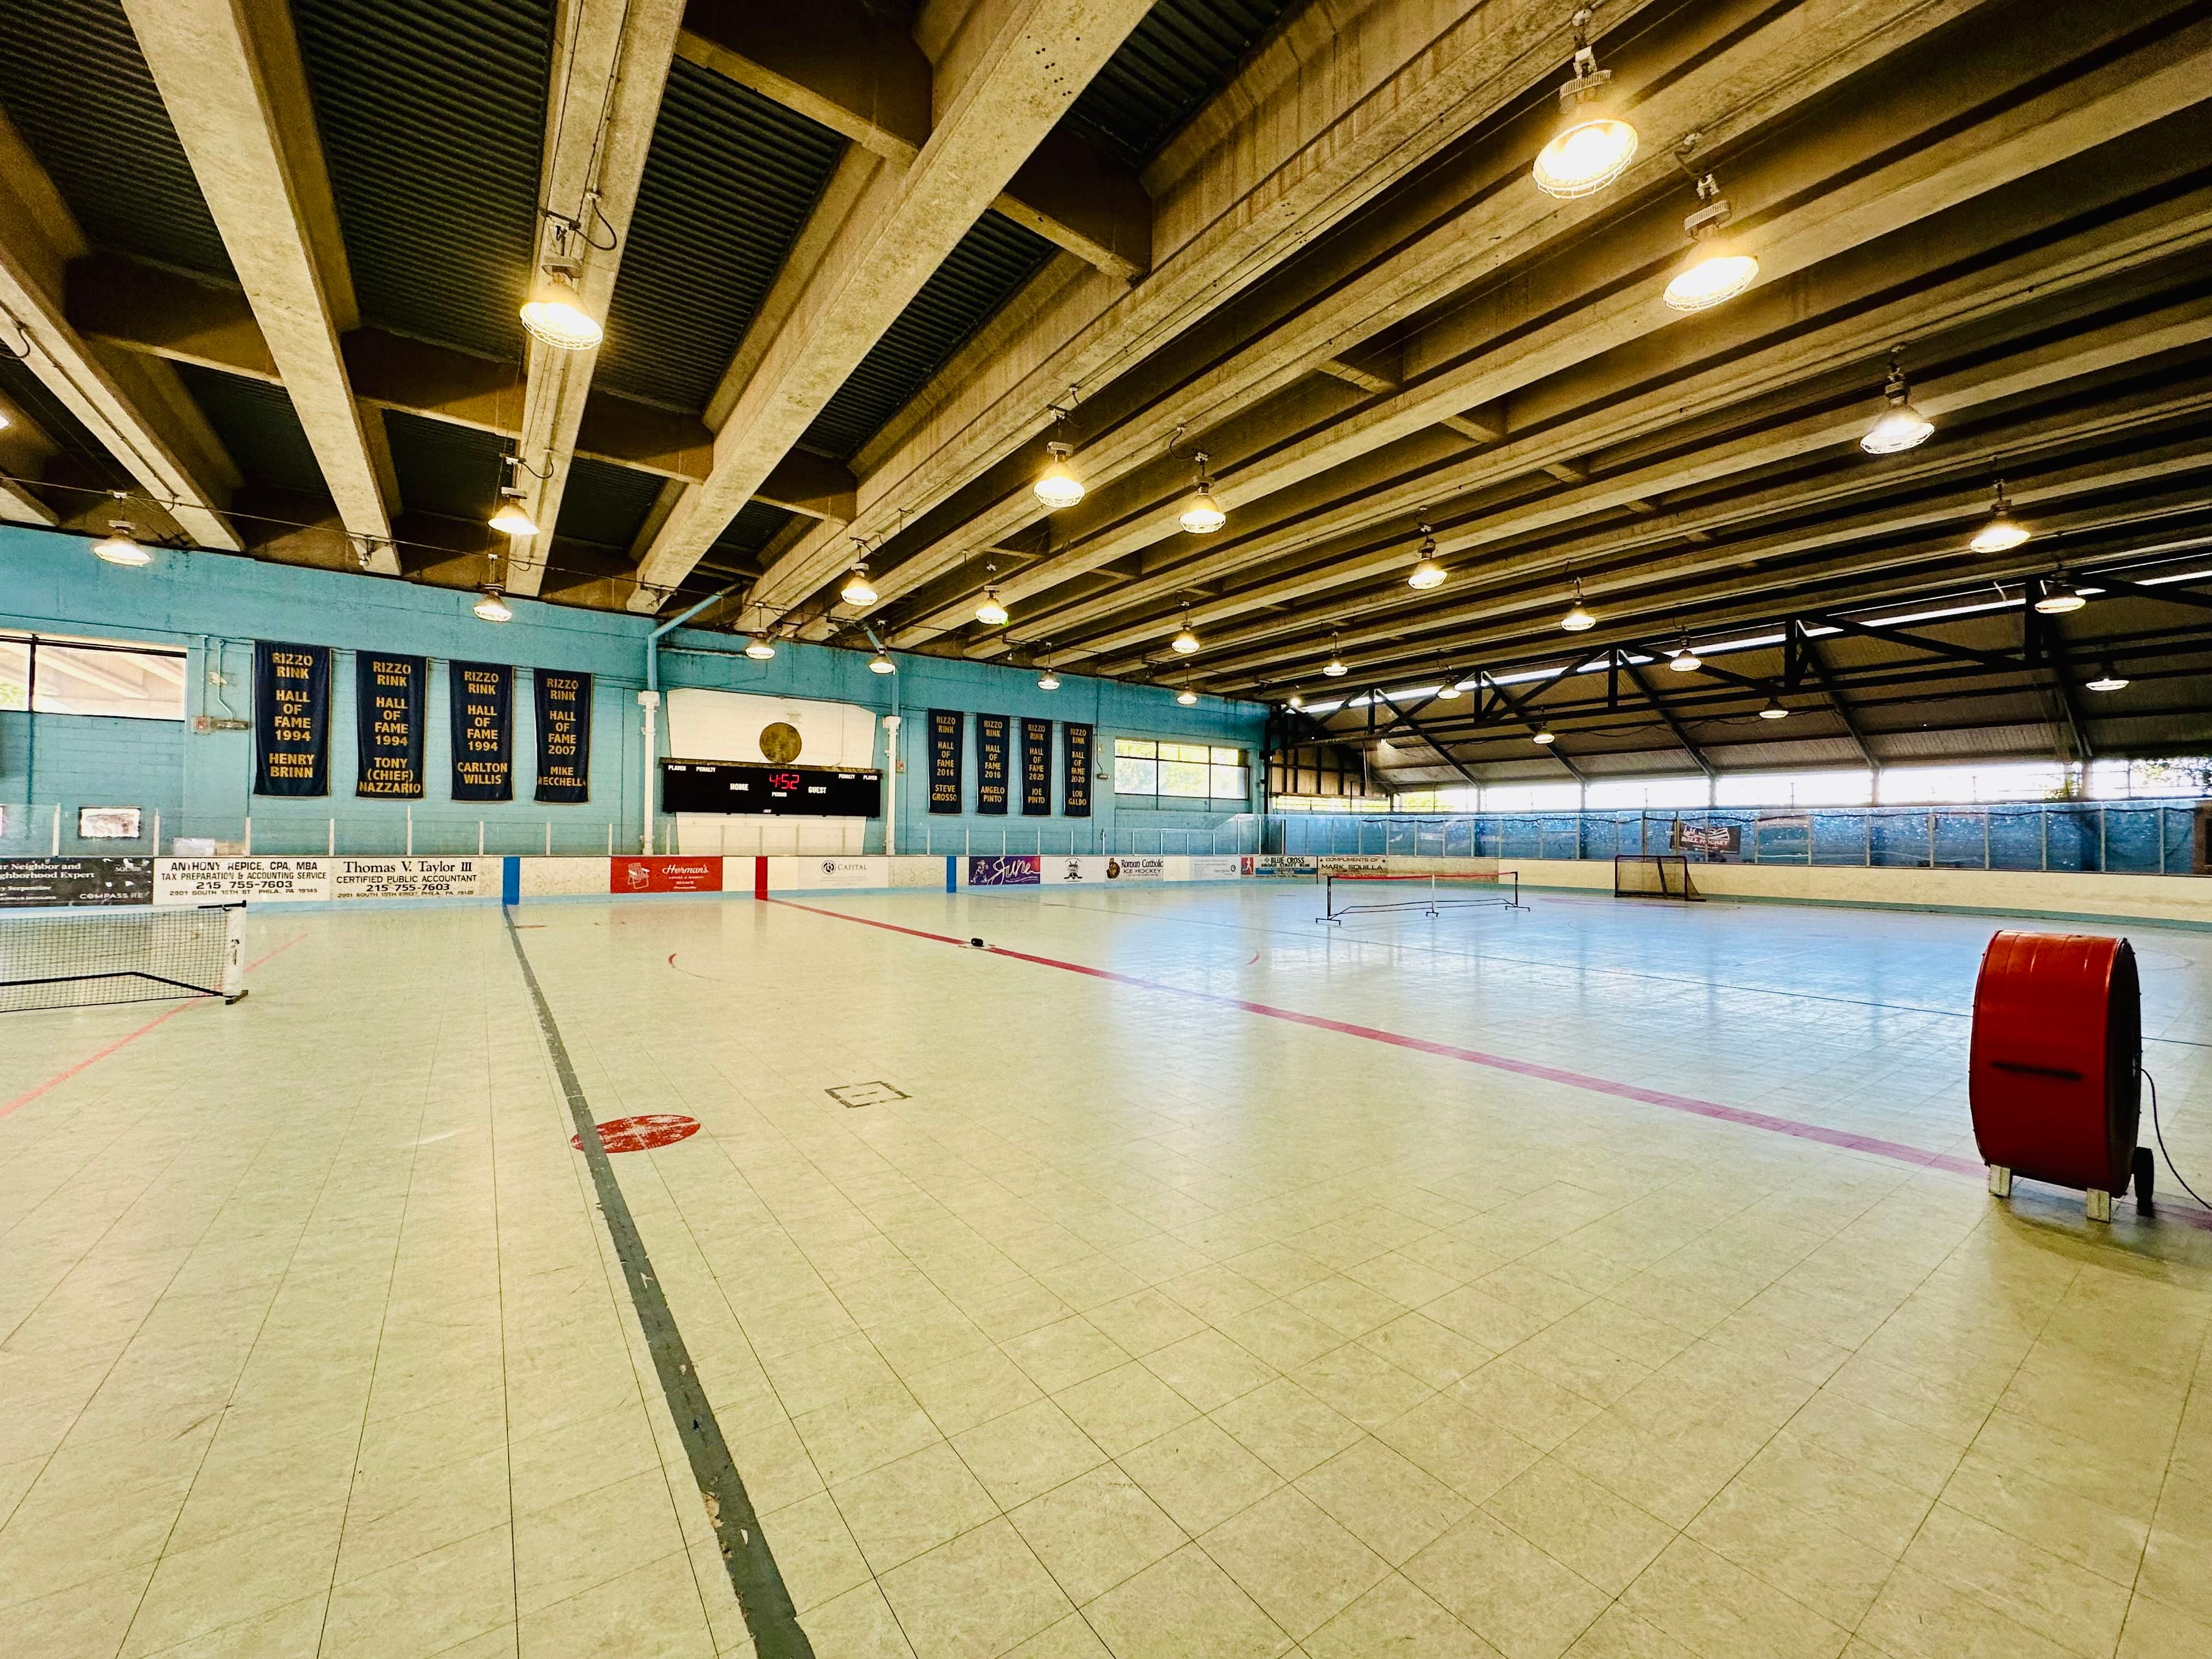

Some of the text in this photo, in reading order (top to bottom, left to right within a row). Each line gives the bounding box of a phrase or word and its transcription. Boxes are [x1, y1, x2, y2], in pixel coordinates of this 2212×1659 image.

[272, 652, 313, 666] RIZZO
[276, 666, 309, 679] RINK
[373, 661, 411, 674] RIZZO
[377, 675, 407, 687] RINK
[464, 671, 499, 683] RIZZO
[468, 683, 496, 695] RINK
[547, 678, 578, 690] RIZZO
[276, 690, 310, 702] HALL
[550, 690, 575, 701] RINK
[376, 696, 408, 709] HALL
[283, 703, 302, 714] OF
[467, 705, 497, 715] HALL
[383, 710, 400, 720] OF
[550, 711, 576, 721] HALL
[274, 716, 311, 728] FAME
[475, 717, 490, 727] OF
[936, 716, 956, 725] RIZZO
[984, 720, 1002, 729] RIZZO
[375, 722, 408, 733] FAME
[555, 722, 570, 732] OF
[938, 725, 954, 734] RINK
[1028, 724, 1046, 732] RIZZO
[275, 730, 311, 741] 1994
[467, 729, 498, 739] FAME
[986, 729, 1001, 737] RINK
[1030, 733, 1043, 741] RINK
[1070, 728, 1086, 737] RIZZO
[376, 735, 408, 746] 1994
[548, 733, 576, 744] FAME
[468, 741, 498, 751] 1994
[548, 745, 576, 755] 2007
[938, 741, 954, 749] HALL
[986, 744, 1001, 753] HALL
[269, 753, 315, 765] HENRY
[1072, 751, 1085, 759] HALL
[374, 757, 408, 768] TONY
[457, 762, 507, 772] CARLTON
[937, 759, 954, 768] FAME
[985, 762, 1001, 770] FAME
[270, 766, 313, 778] BRINN
[550, 766, 574, 776] MIKE
[937, 768, 954, 777] 2016
[1029, 764, 1044, 772] FAME
[368, 768, 414, 781] (CHIEF)
[464, 774, 502, 784] WILLIS
[769, 774, 799, 790] 4:52
[359, 782, 421, 793] NAZZARIO
[935, 785, 956, 793] STEVE
[980, 786, 1005, 794] ANGELO
[932, 793, 957, 801] GROSSO
[11, 863, 60, 871] Neighbor
[171, 862, 220, 870] ANTHONY
[270, 862, 290, 871] CPA,
[297, 862, 317, 870] MBA
[343, 861, 472, 874] Thomas V. Taylor III
[662, 863, 709, 874] Herman's
[1122, 859, 1164, 868] Roman Catholic
